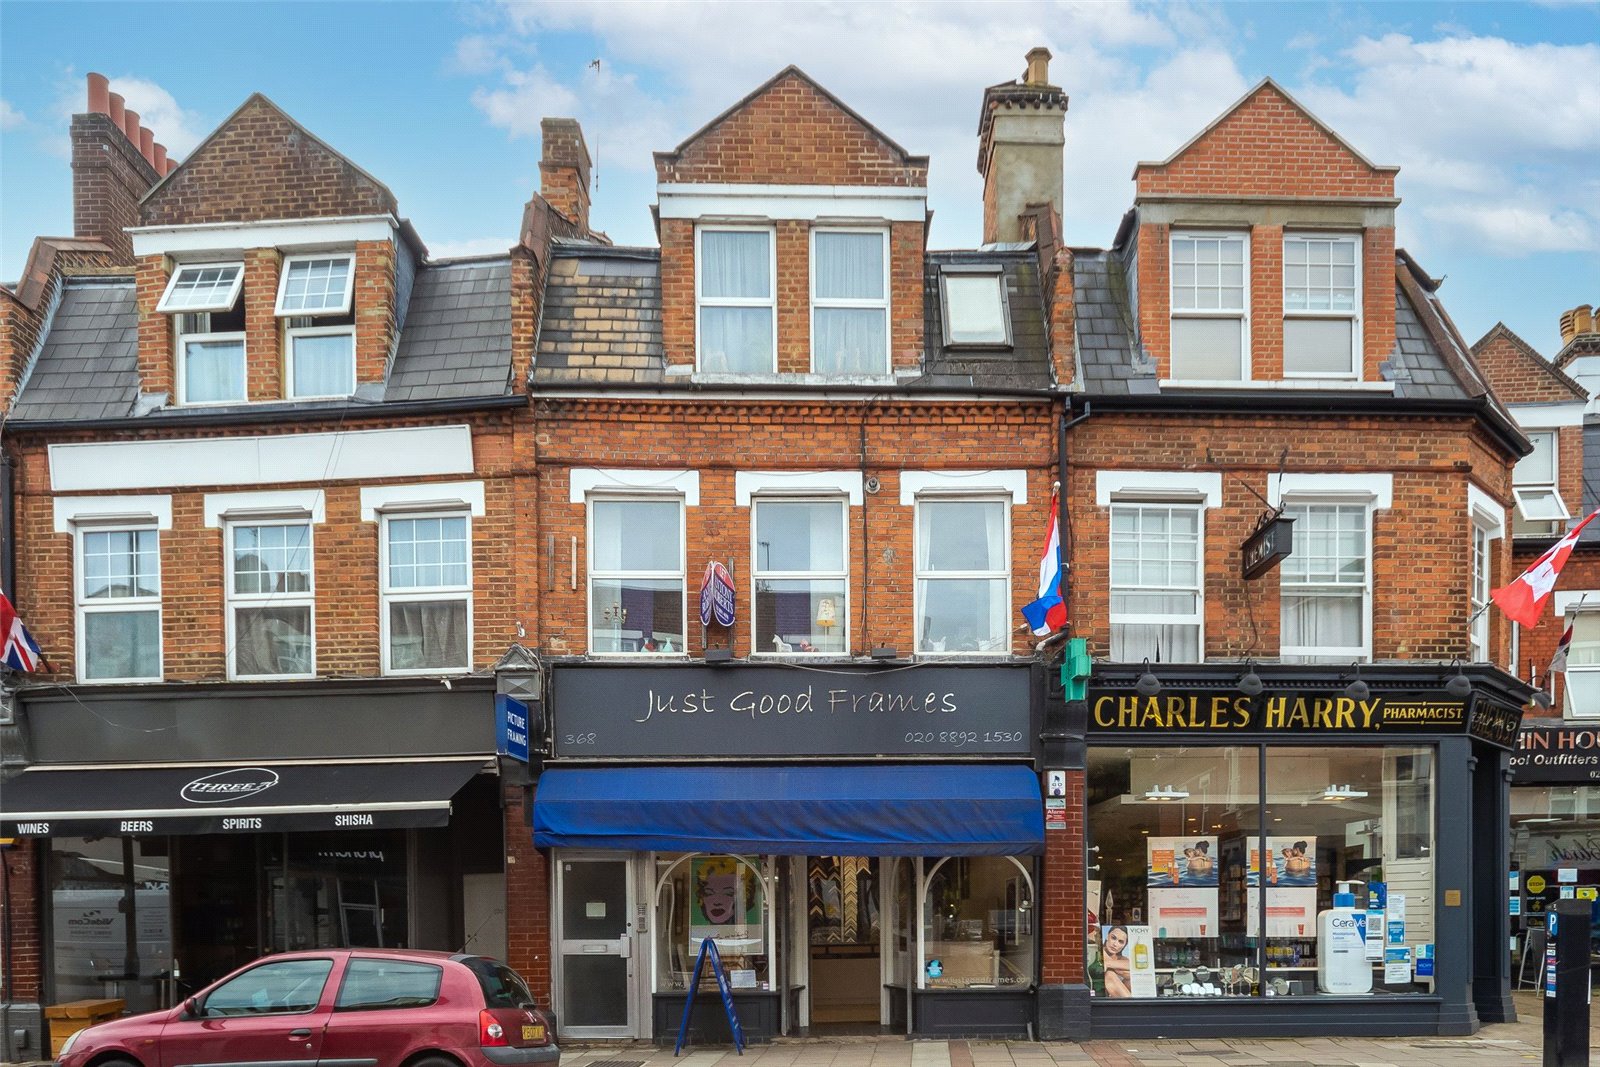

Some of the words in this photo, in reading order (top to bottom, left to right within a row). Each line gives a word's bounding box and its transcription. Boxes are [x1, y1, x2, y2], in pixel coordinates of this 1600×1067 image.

[635, 688, 715, 723] Just
[729, 685, 814, 720] Good
[828, 689, 958, 714] Frames
[507, 711, 526, 730] PICTURE
[1094, 696, 1251, 728] CHARLES
[1265, 697, 1382, 731] HARRY,
[507, 728, 527, 747] FRAMING
[564, 732, 597, 745] 368
[904, 732, 935, 743] 020
[939, 731, 978, 748] 8892
[983, 731, 1023, 743] 1530
[1558, 731, 1600, 750] HO
[1534, 754, 1599, 766] Outfitters
[120, 820, 153, 832] BEERS
[222, 818, 262, 830] SPIRITS
[334, 814, 374, 826] SHISHA
[17, 823, 50, 834] WINES
